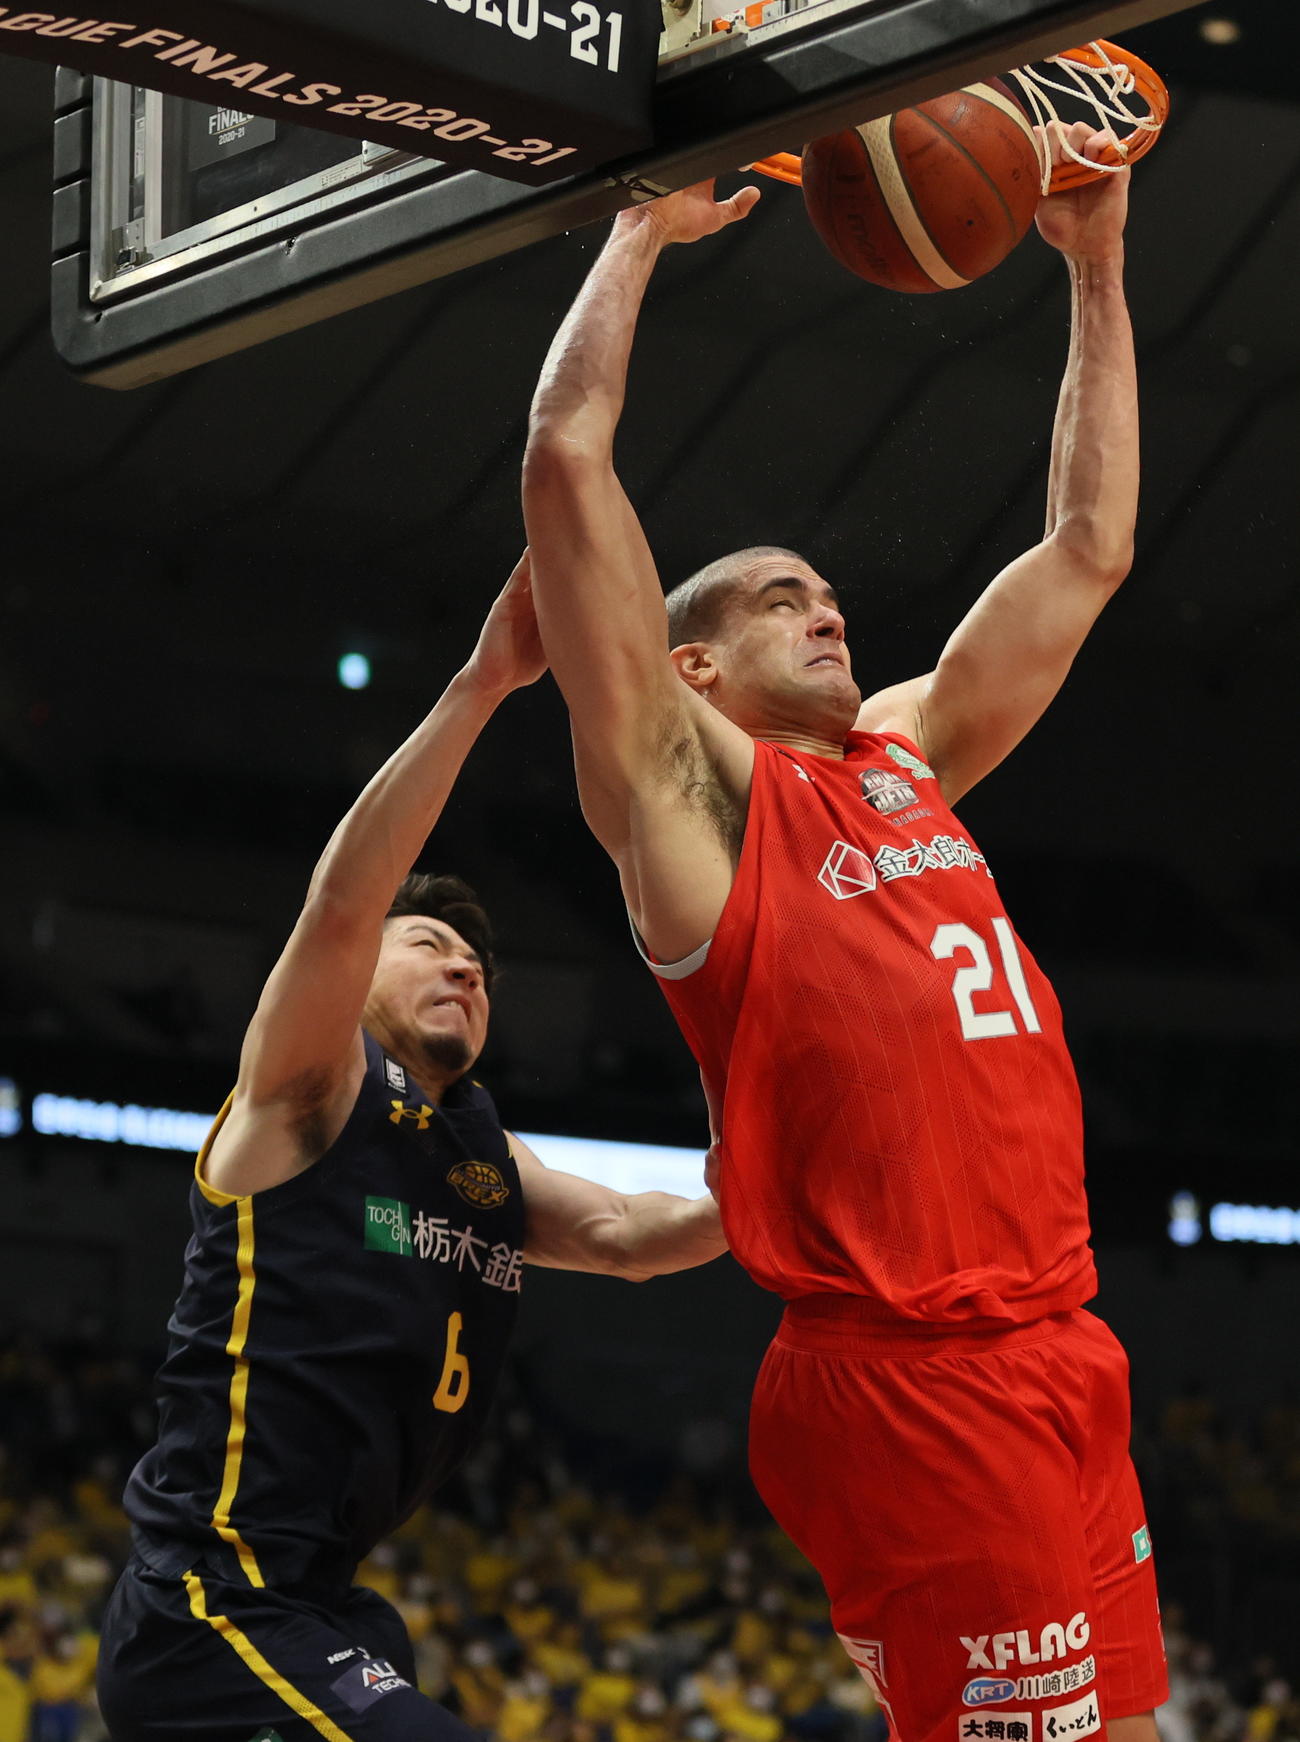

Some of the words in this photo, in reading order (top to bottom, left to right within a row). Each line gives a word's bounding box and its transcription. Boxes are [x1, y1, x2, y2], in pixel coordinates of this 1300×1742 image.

[427, 0, 623, 72] 0-21
[0, 6, 137, 43] GUE
[118, 28, 342, 105] FINALS
[326, 94, 578, 166] 2020-21
[218, 126, 245, 146] 2020-21
[929, 916, 1043, 1041] 21
[432, 1311, 470, 1413] 6
[959, 1611, 1090, 1670] XFLAG
[967, 1682, 1009, 1702] KRT
